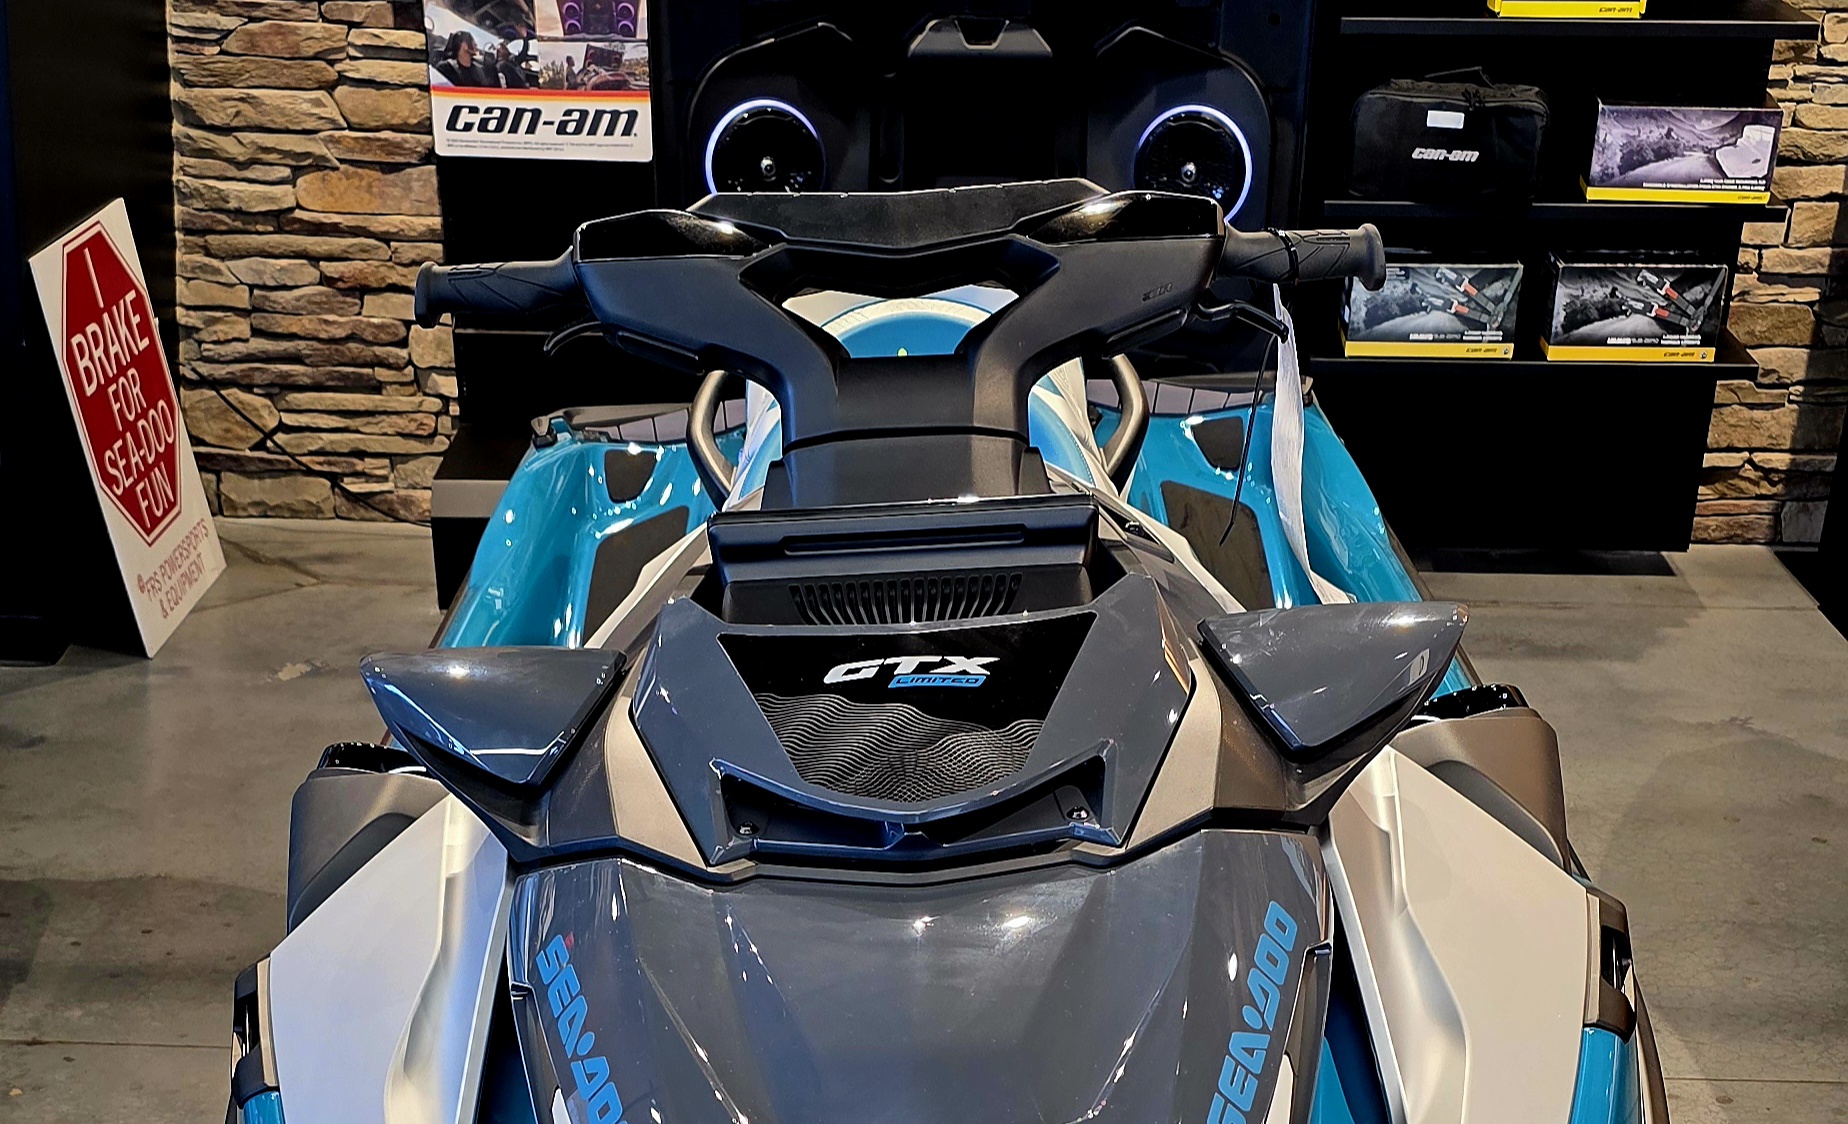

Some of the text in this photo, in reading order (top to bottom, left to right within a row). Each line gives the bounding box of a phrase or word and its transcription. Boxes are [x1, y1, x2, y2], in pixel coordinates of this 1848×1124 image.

[445, 104, 640, 137] can-am
[1411, 147, 1480, 162] can-am
[70, 289, 150, 397] BRAKE
[106, 367, 147, 432] FOR
[103, 398, 175, 497] SEA-DOO
[134, 472, 175, 529] FUN
[164, 551, 205, 611] EQUIPMENT
[823, 655, 1001, 684] GTX
[895, 676, 980, 685] LIMITED
